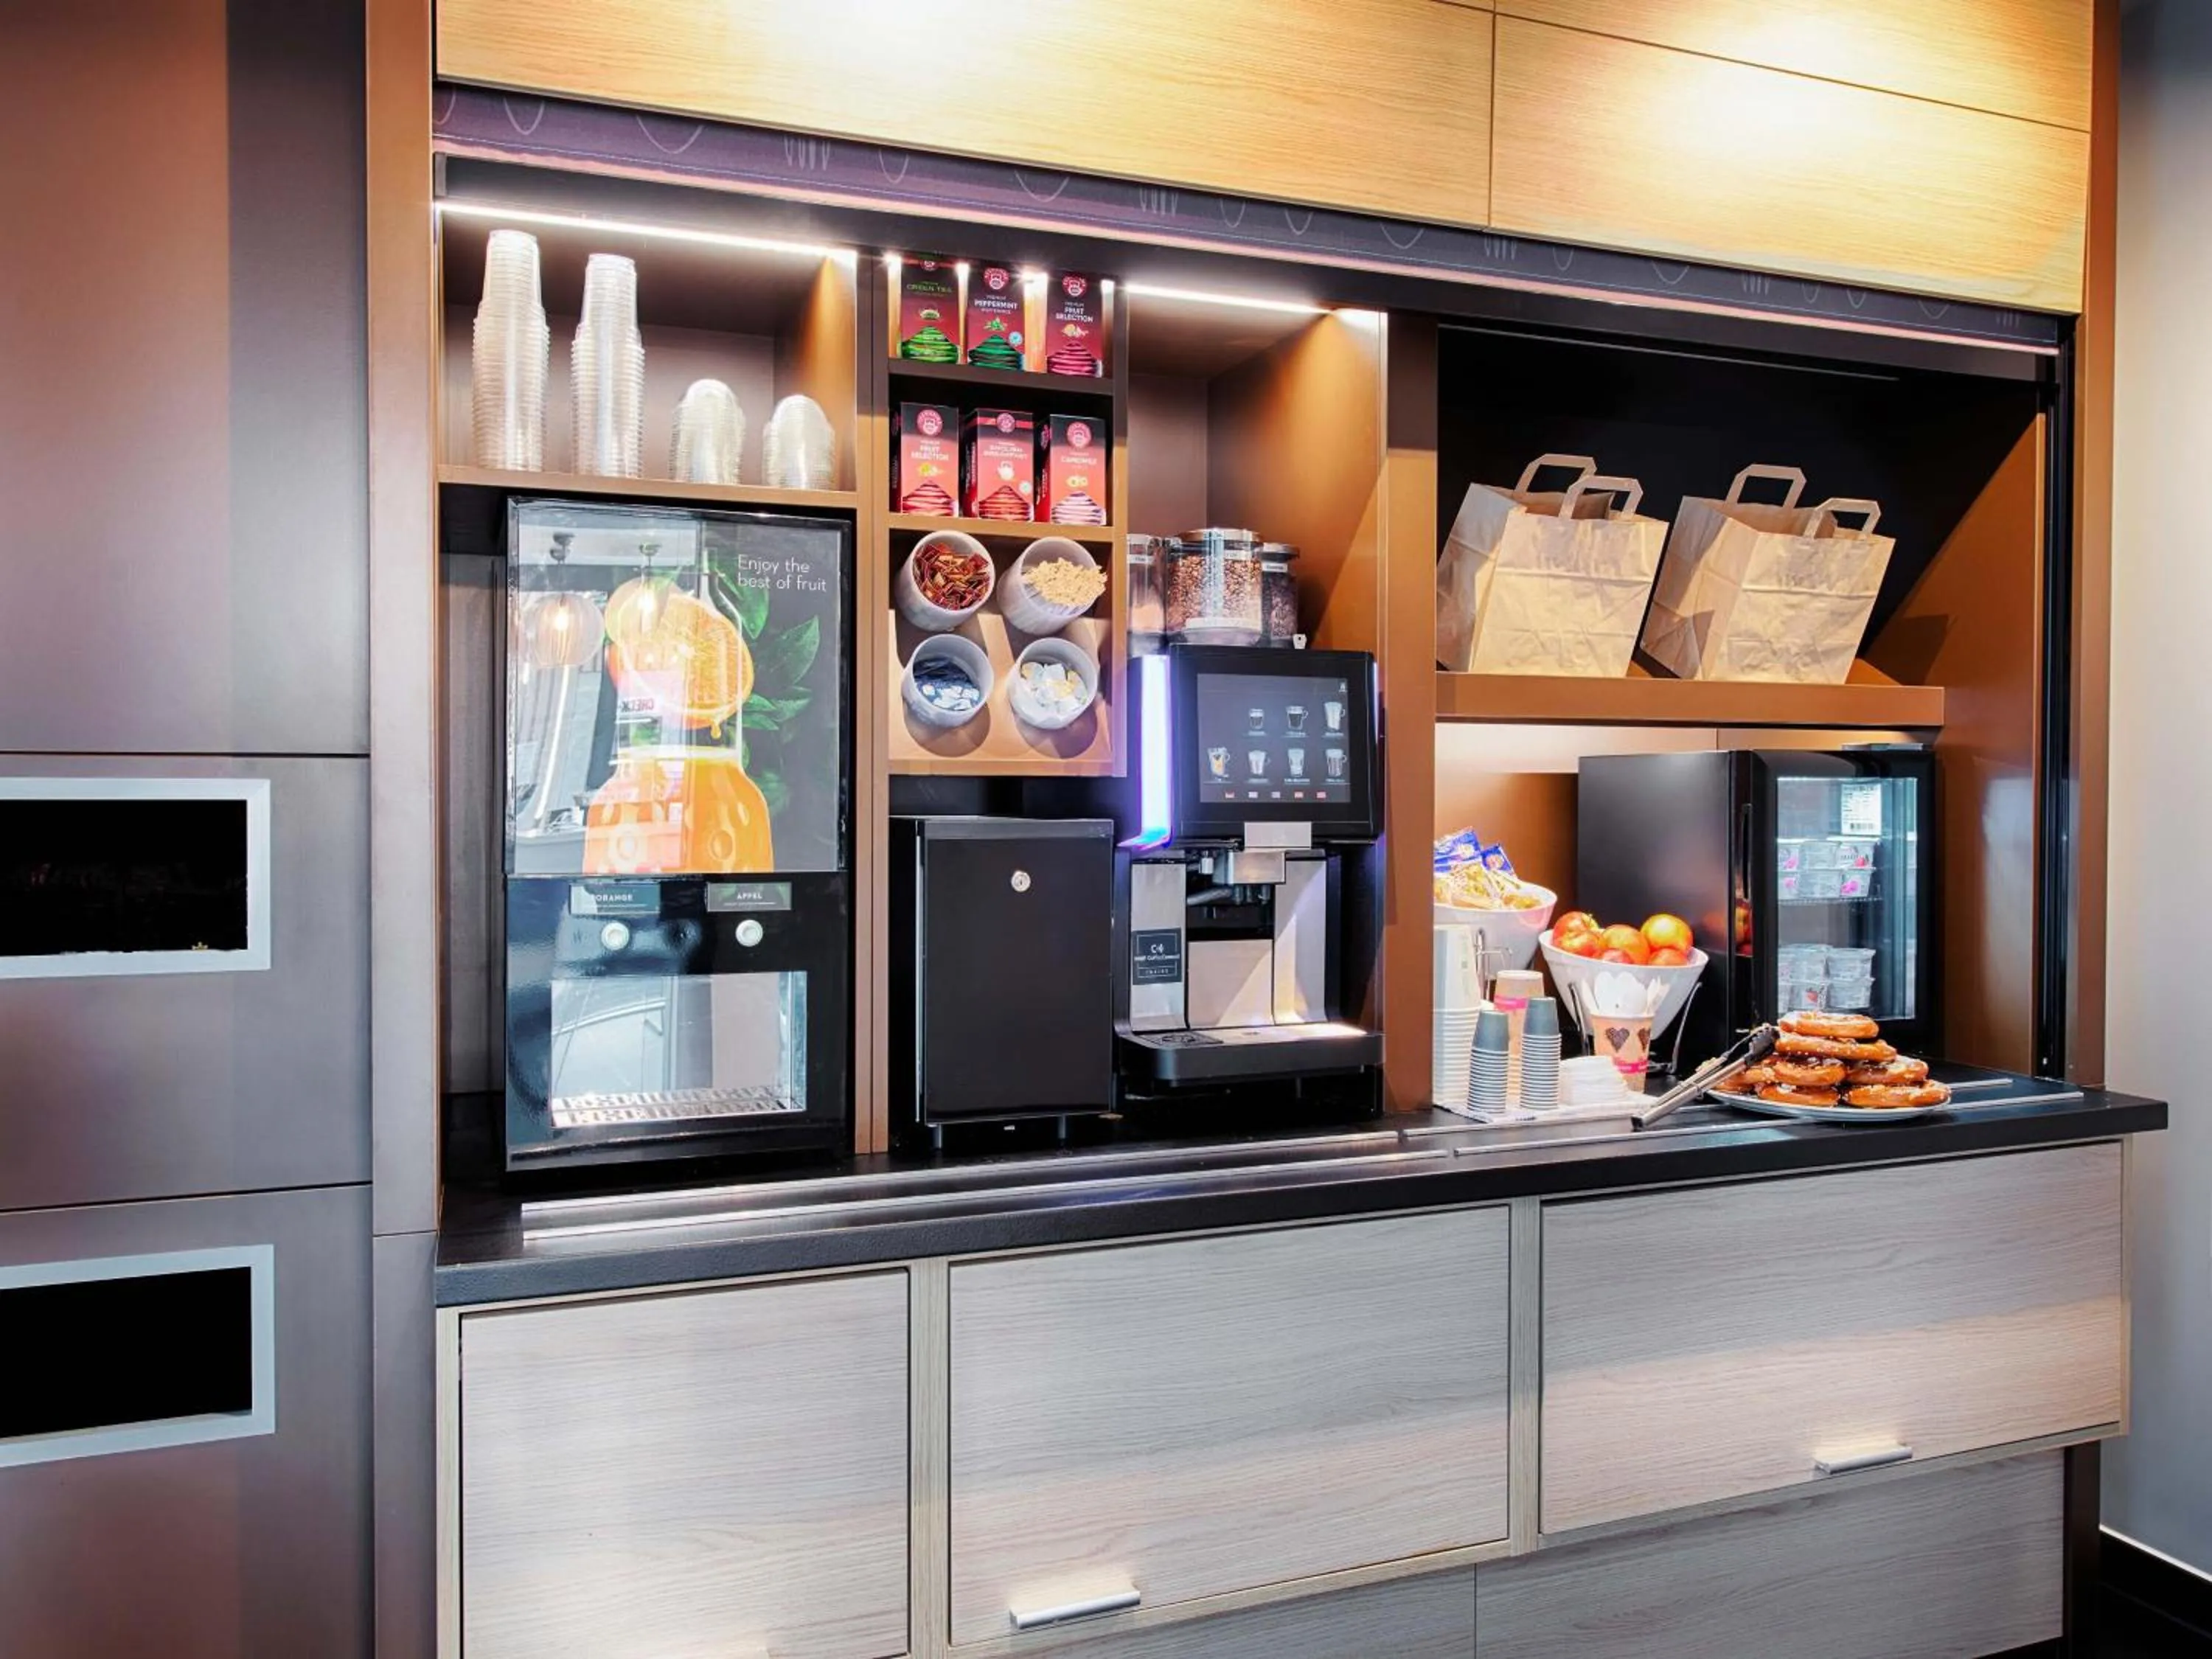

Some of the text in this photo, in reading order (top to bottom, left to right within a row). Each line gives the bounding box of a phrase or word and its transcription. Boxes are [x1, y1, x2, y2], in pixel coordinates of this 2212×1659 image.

[974, 299, 1018, 310] PEPPERMINT
[1064, 307, 1085, 315] FRUIT
[1055, 313, 1093, 323] SELECTION
[737, 554, 810, 574] Enjoy the
[737, 572, 827, 592] best of fruit
[596, 894, 633, 902] ORANGE
[737, 891, 762, 900] APPEL
